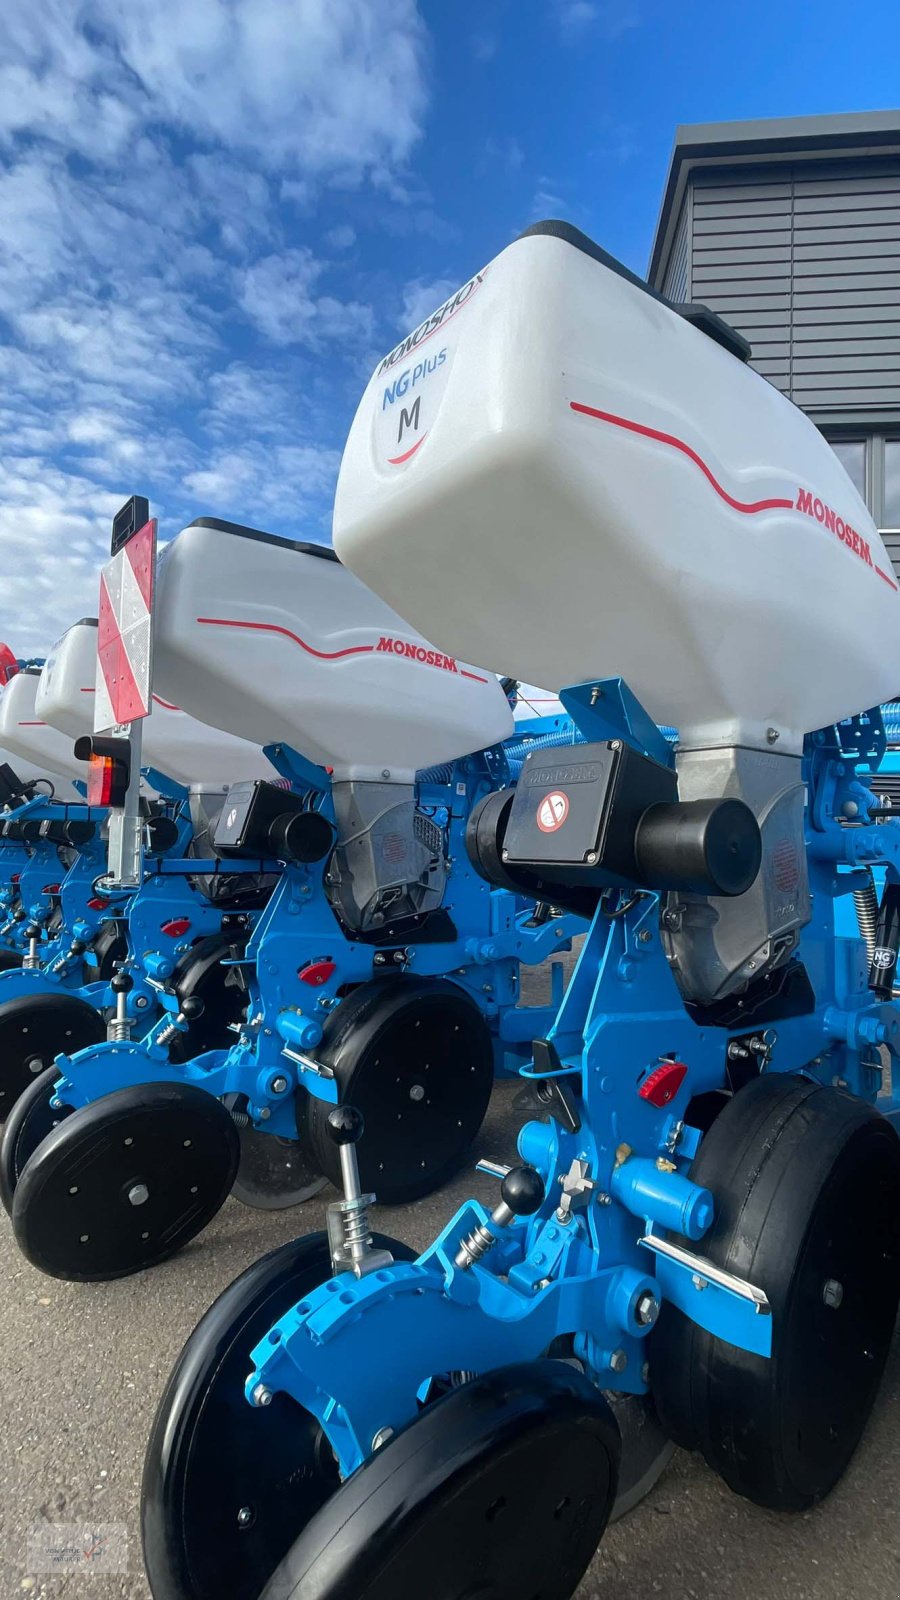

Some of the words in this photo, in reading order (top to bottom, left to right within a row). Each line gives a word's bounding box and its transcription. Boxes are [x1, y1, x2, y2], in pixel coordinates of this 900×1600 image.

[382, 369, 410, 411] NG
[397, 395, 421, 444] M
[796, 488, 873, 567] MONOSEM
[376, 637, 458, 673] MONOSEM
